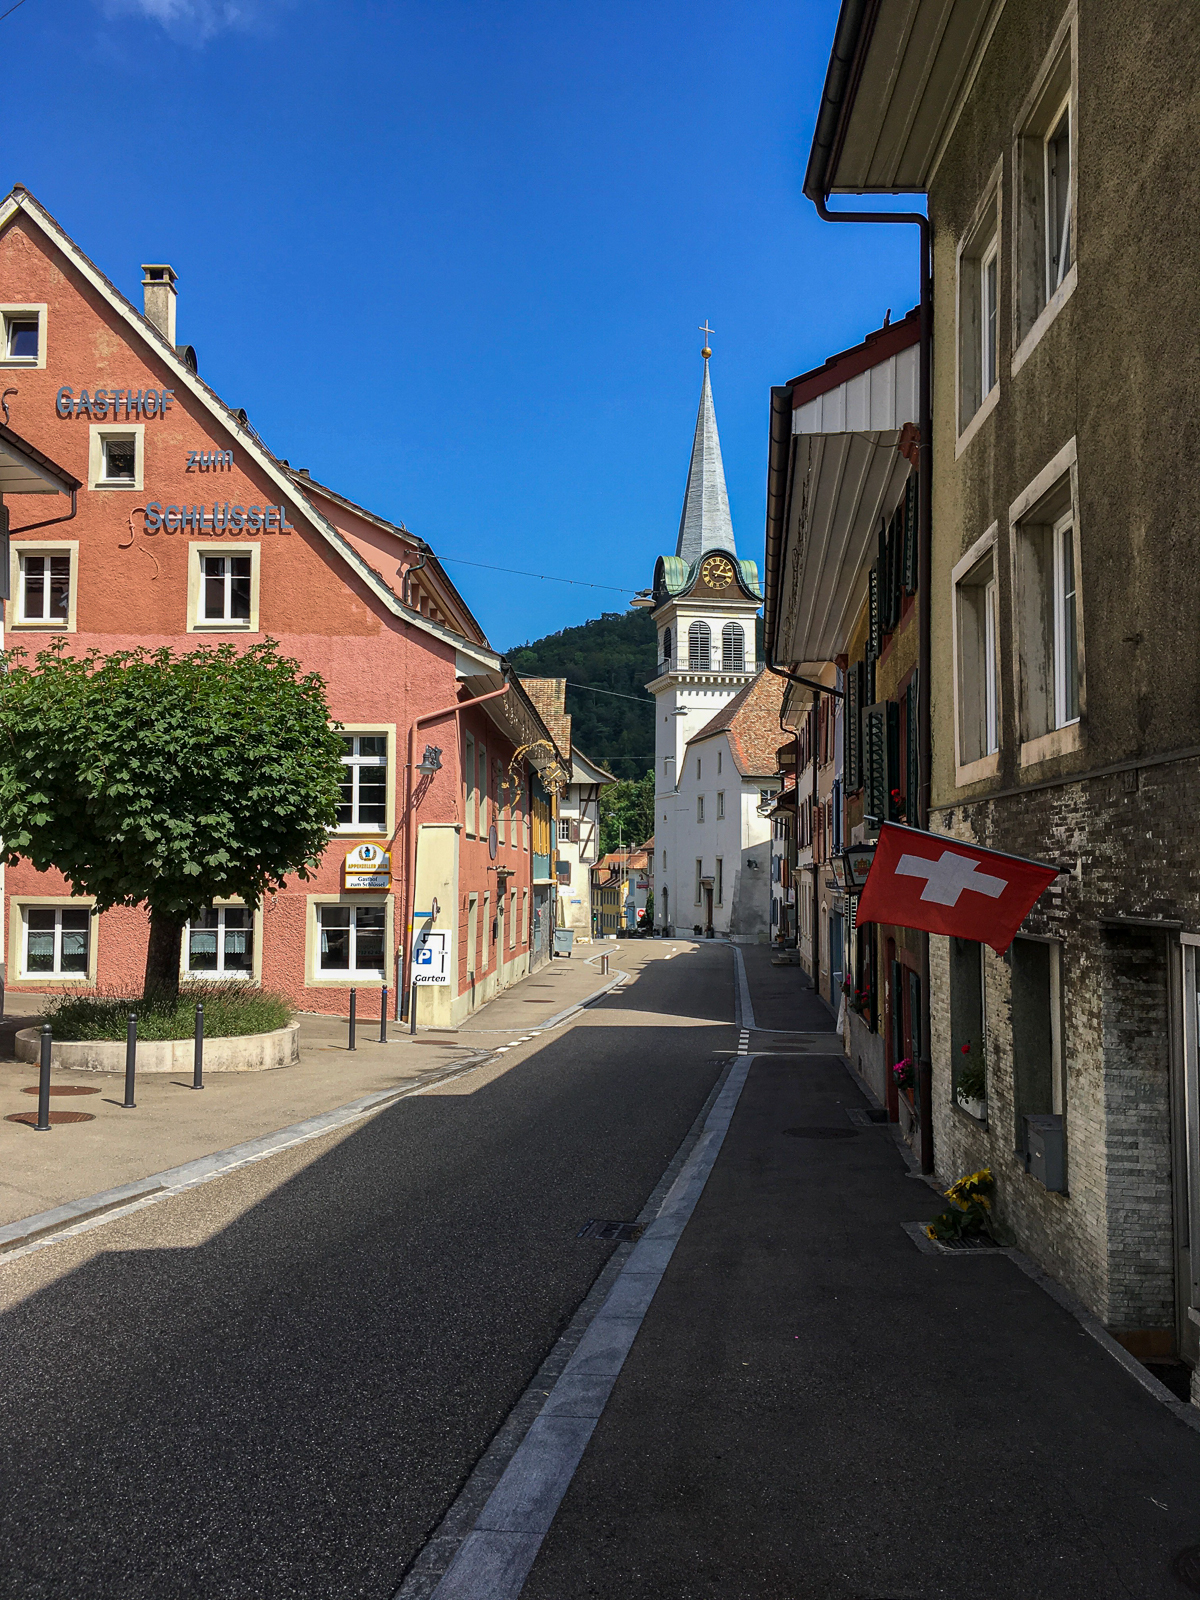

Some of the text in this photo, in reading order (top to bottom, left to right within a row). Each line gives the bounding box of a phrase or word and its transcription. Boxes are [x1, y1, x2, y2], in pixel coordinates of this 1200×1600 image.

[56, 386, 175, 413] GASTHOF
[187, 449, 234, 466] zum
[144, 501, 294, 529] SCHLÜSSEL
[418, 949, 431, 963] P
[415, 974, 446, 982] Garten
